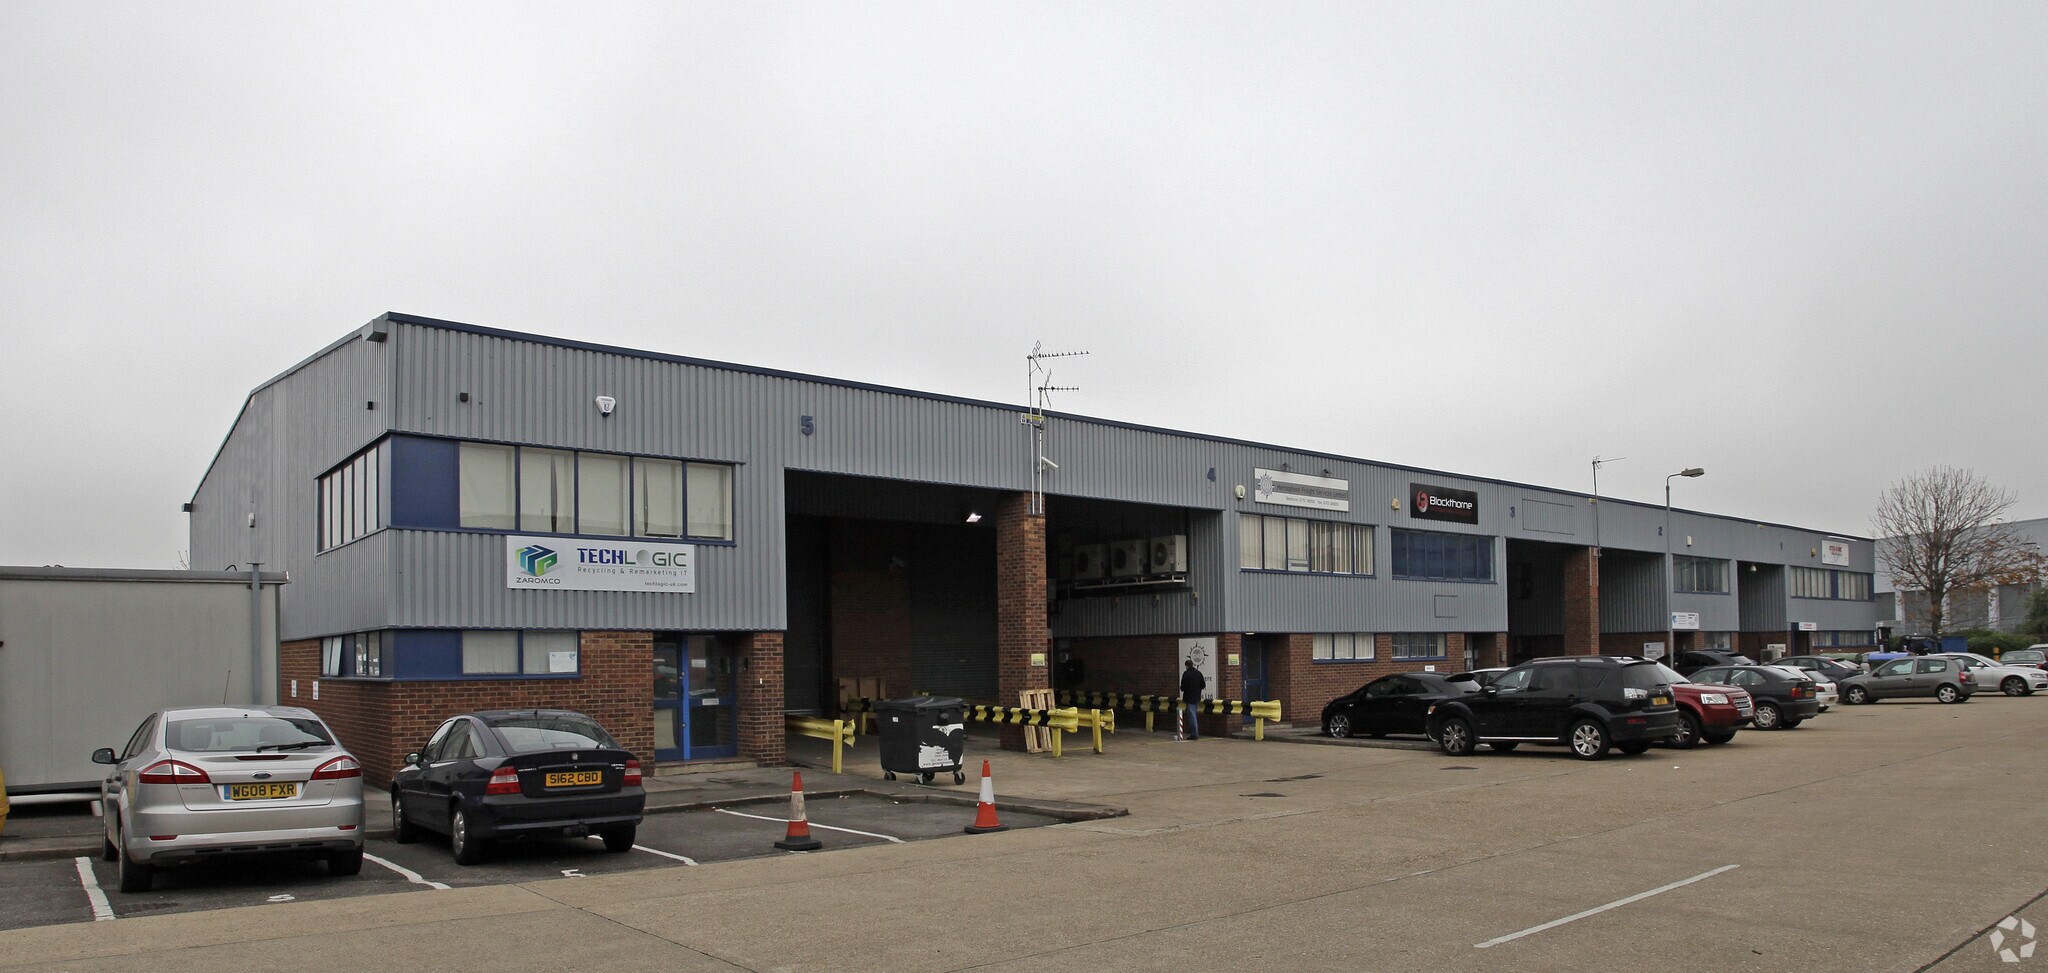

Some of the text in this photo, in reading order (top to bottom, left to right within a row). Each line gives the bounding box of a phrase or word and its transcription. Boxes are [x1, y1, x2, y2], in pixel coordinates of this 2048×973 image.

[801, 415, 814, 436] 5
[1207, 467, 1216, 482] 4
[1510, 506, 1515, 518] 3
[1658, 526, 1663, 536] 2
[577, 566, 618, 575] Recycling
[629, 568, 677, 577] Remarketing
[516, 577, 561, 585] ZAROMCO
[549, 772, 599, 784] S162 CBD
[232, 783, 296, 798] WG08 FXR
